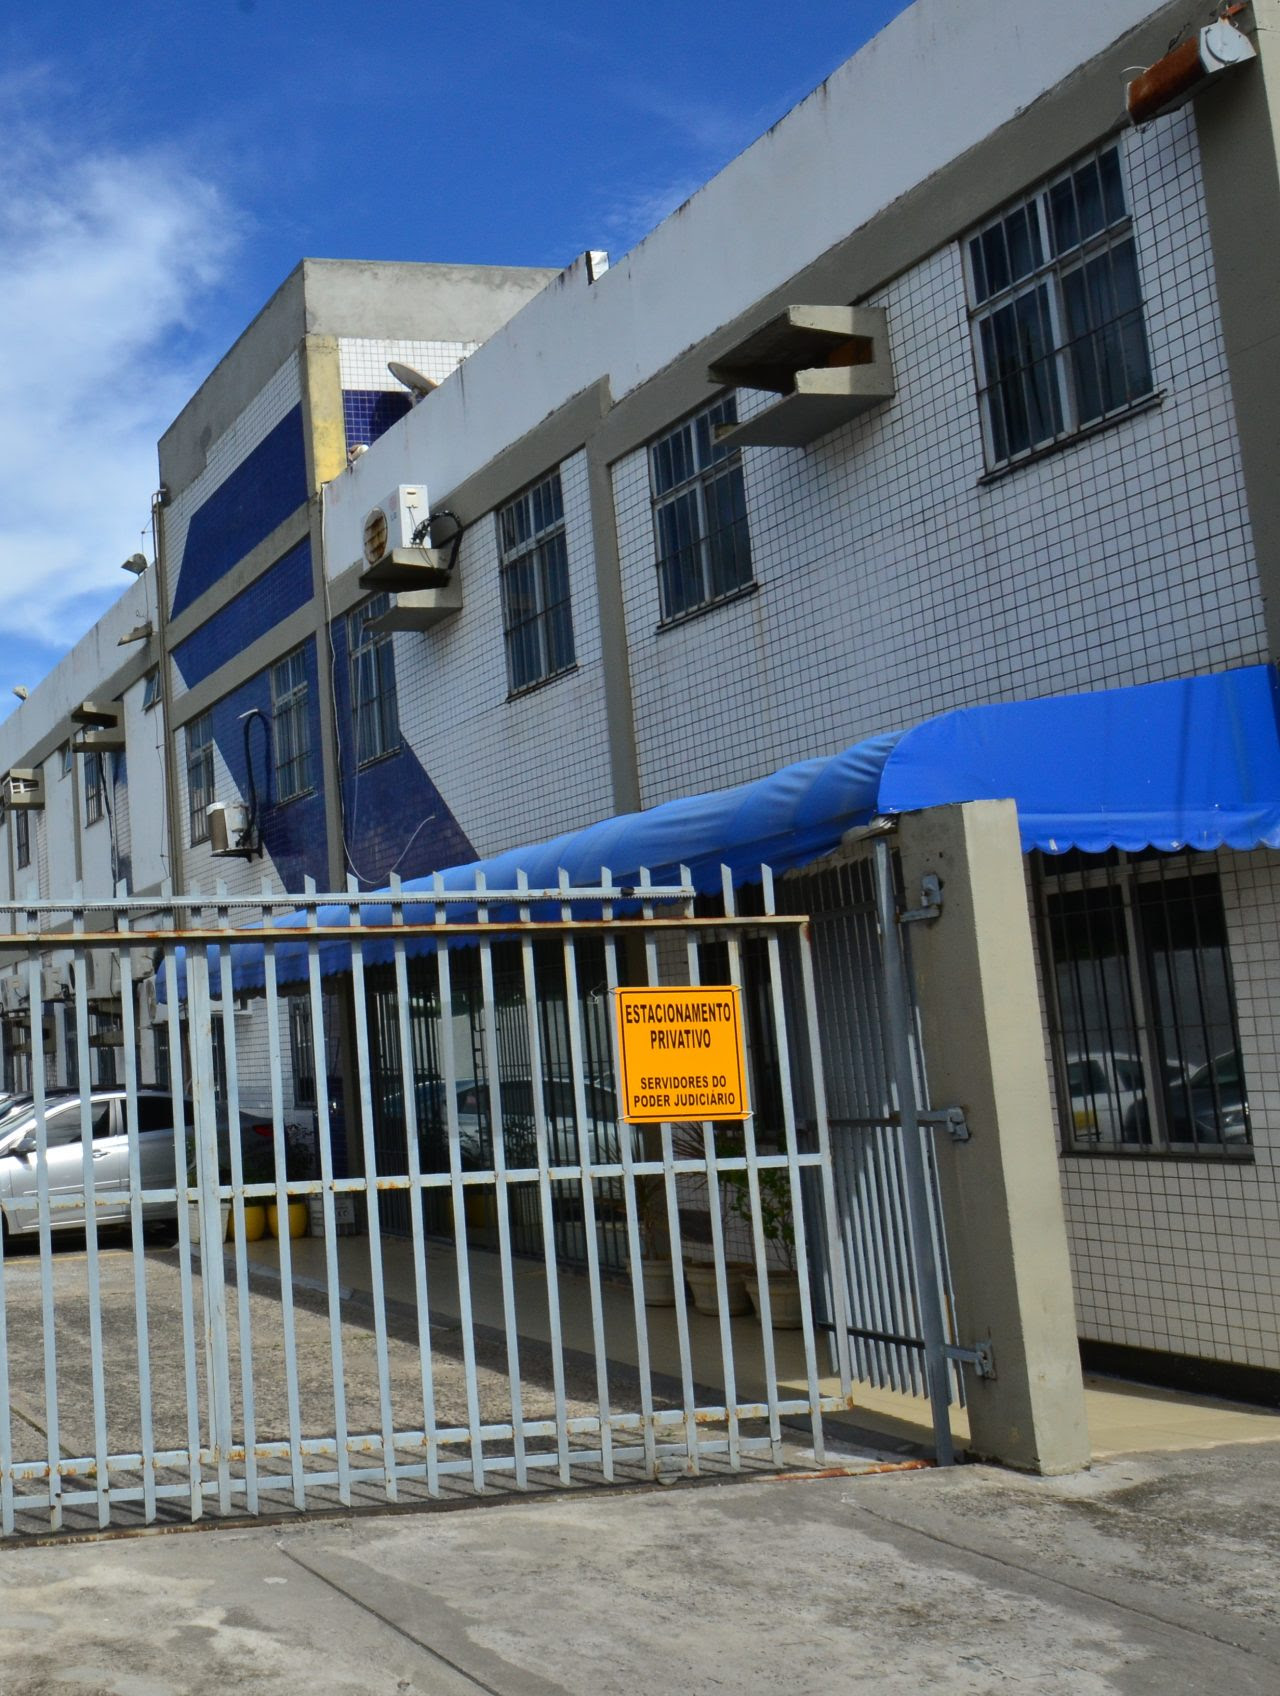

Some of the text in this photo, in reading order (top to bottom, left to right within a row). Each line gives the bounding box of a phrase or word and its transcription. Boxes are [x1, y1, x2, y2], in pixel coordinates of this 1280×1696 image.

[625, 1003, 731, 1024] ESTACIONAMENTO
[650, 1029, 711, 1049] PRIVATIVO
[640, 1075, 726, 1090] SERVIDORES DO
[634, 1090, 735, 1108] PODER JUDICIÁRIO
